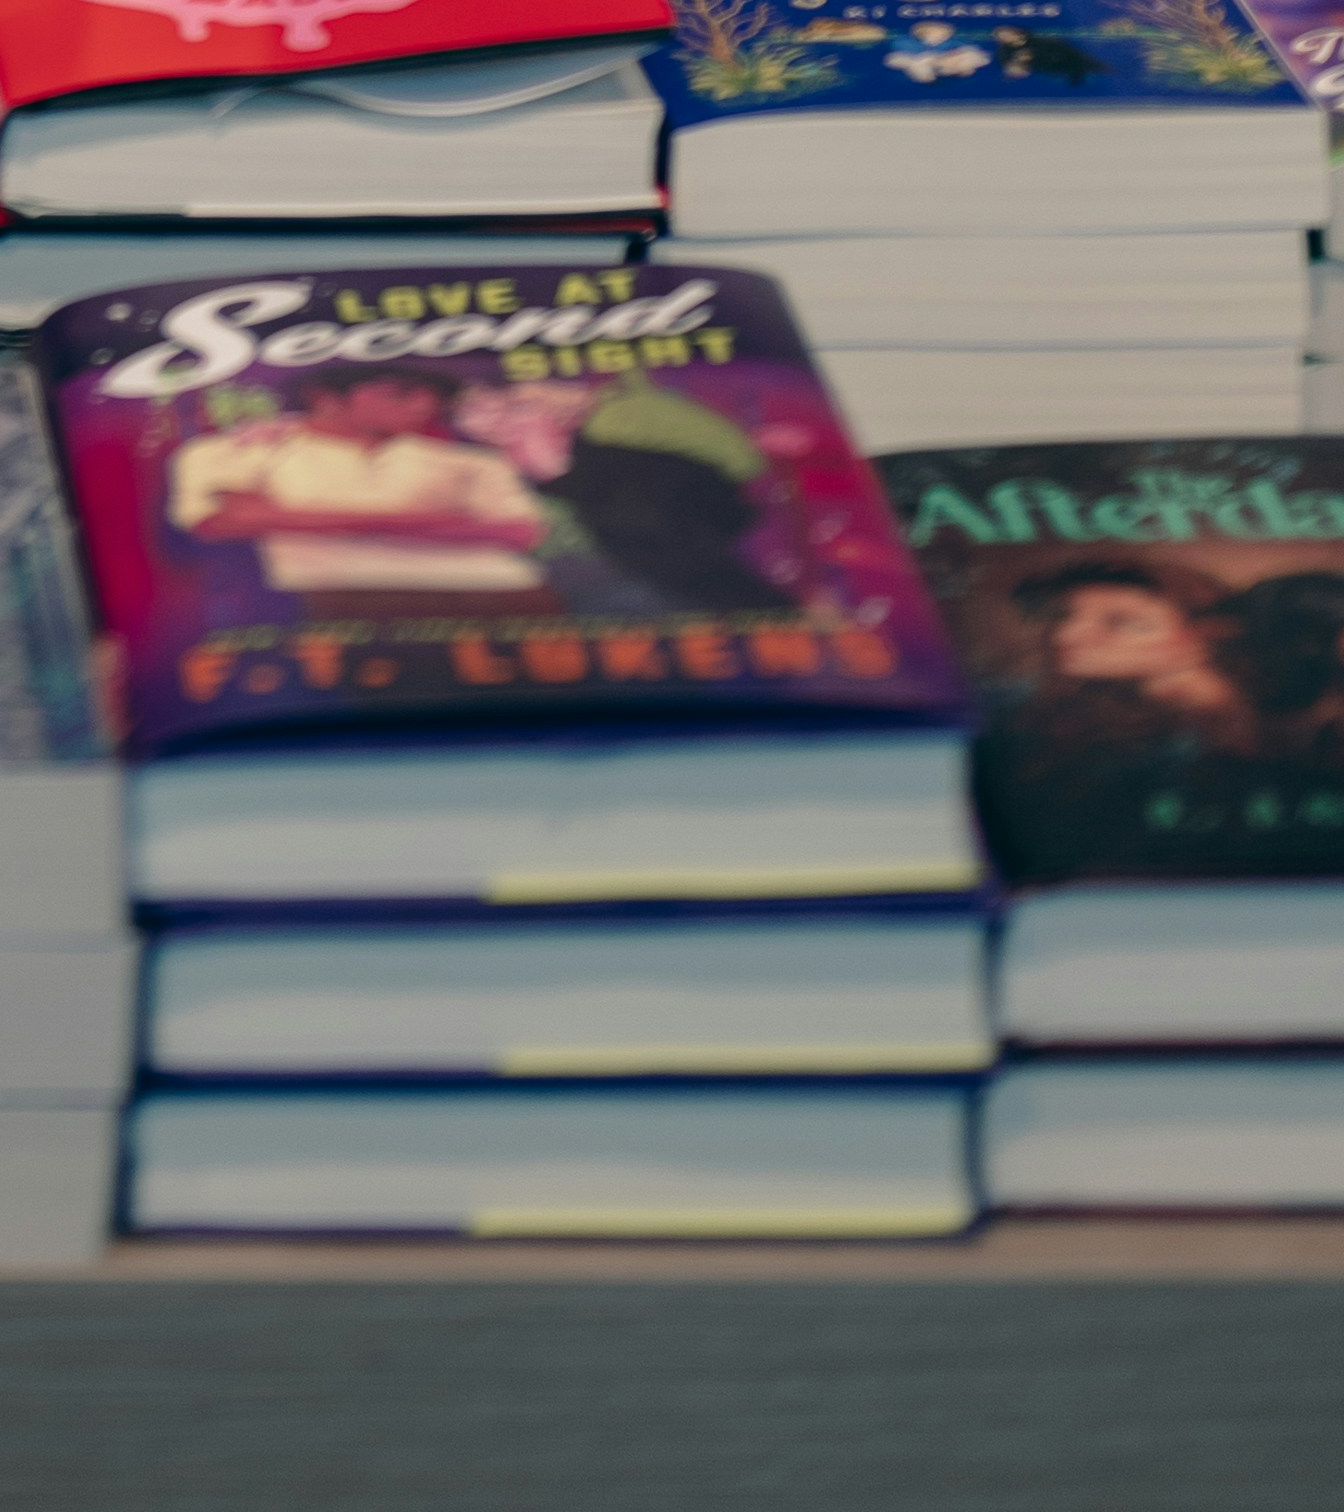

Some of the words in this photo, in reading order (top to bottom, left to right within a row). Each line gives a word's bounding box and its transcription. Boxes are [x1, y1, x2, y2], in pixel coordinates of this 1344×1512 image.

[336, 278, 522, 323] LOVE
[555, 267, 641, 305] AT
[101, 277, 717, 397] Second
[500, 328, 737, 380] SIGHT
